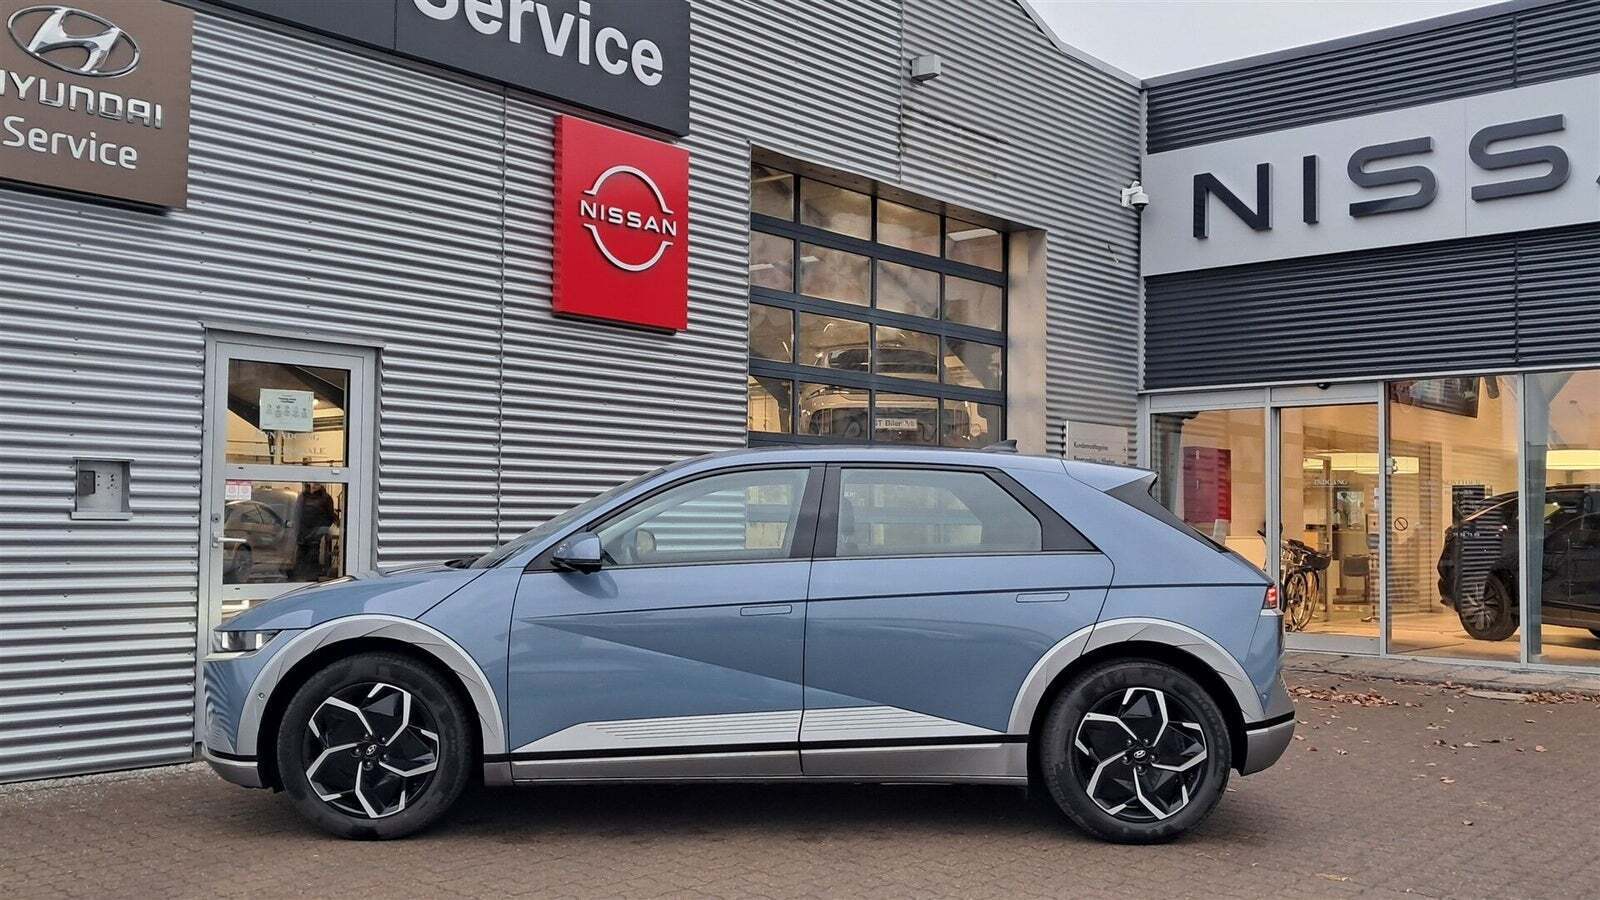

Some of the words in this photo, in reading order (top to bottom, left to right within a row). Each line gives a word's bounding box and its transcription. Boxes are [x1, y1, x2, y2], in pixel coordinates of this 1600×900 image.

[412, 0, 664, 86] ervice
[3, 115, 138, 170] Service
[1193, 114, 1600, 239] NISS
[580, 199, 677, 237] NISSAN
